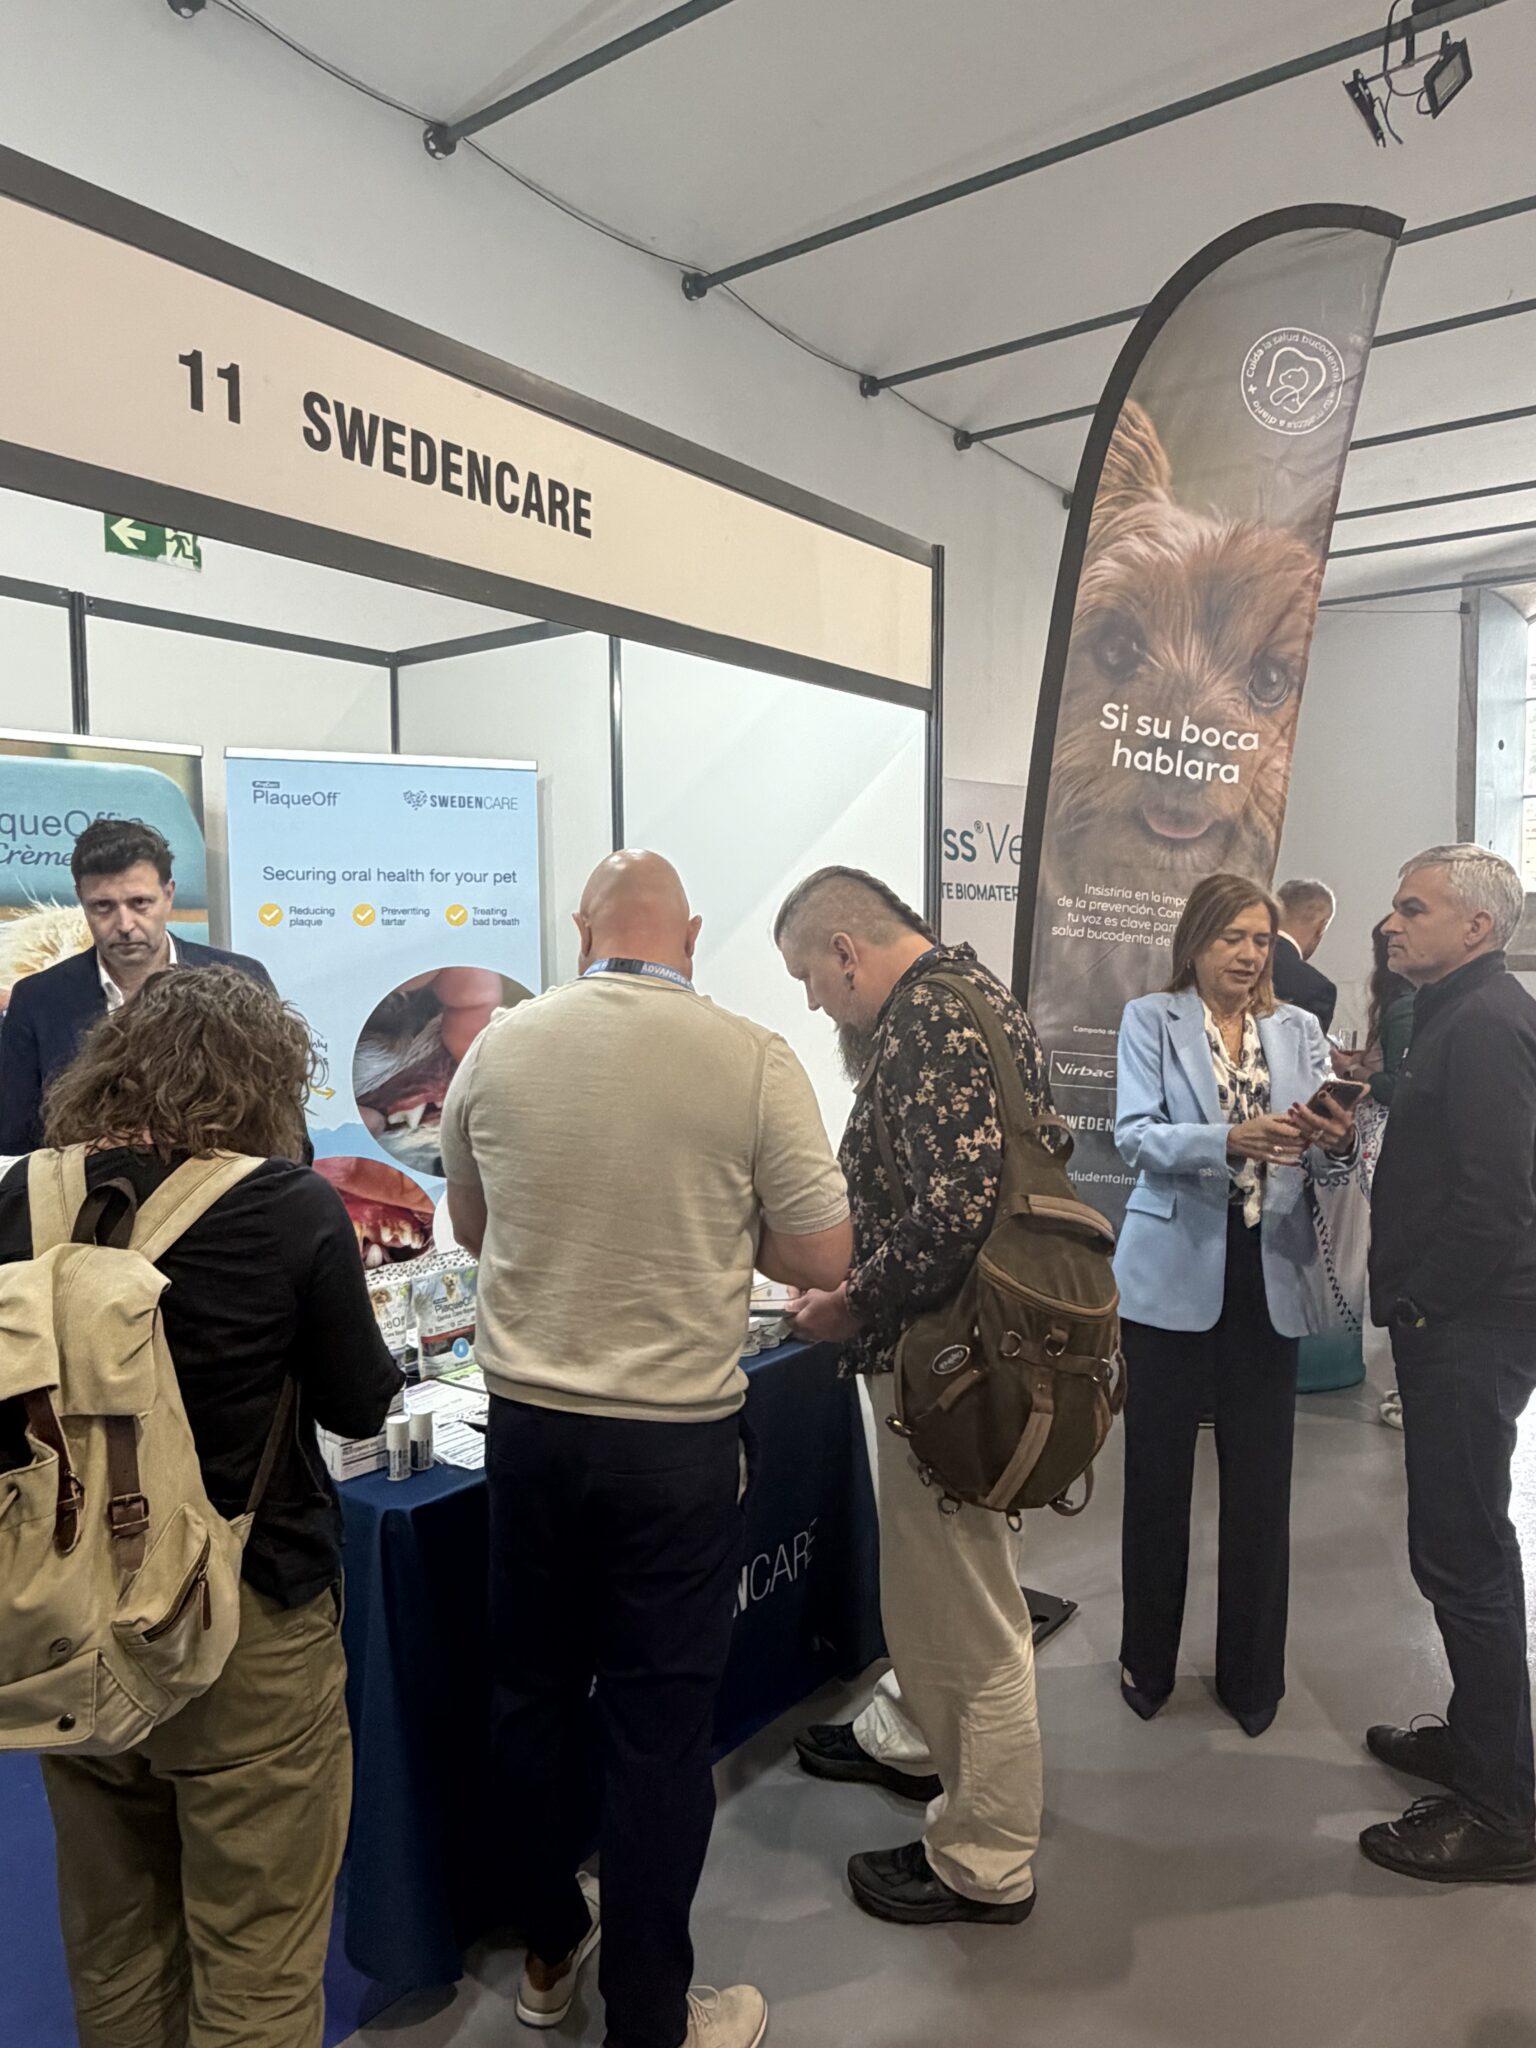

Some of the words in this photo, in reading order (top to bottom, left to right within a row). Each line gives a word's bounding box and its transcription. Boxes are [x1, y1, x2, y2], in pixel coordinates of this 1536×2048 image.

[178, 349, 241, 424] 11
[302, 391, 593, 539] SWEDENCARE
[1099, 702, 1128, 732] Si
[1135, 715, 1171, 740] su
[1180, 716, 1260, 751] boca
[1111, 740, 1240, 784] hablara
[429, 794, 519, 810] SWEDENCARE
[0, 810, 116, 842] queO
[263, 866, 336, 884] Securing
[341, 868, 372, 882] oral
[377, 868, 425, 883] health
[429, 868, 451, 883] for
[454, 871, 488, 886] your
[493, 870, 518, 886] pet
[1084, 883, 1132, 899] Insistiría
[1134, 891, 1149, 901] en
[1151, 891, 1161, 903] la
[289, 906, 335, 917] Reducing
[381, 907, 430, 918] Preventing
[472, 907, 508, 917] Treating
[1057, 895, 1073, 908] de
[1075, 897, 1086, 909] la
[1088, 900, 1156, 916] prevención.
[289, 917, 323, 927] plaque
[381, 917, 406, 926] tartar
[472, 917, 490, 926] bad
[492, 917, 520, 926] breath
[1067, 912, 1079, 923] tu
[1082, 914, 1102, 925] voz
[1104, 916, 1118, 927] es
[1120, 917, 1152, 930] clave
[1051, 925, 1085, 938] salud
[1087, 928, 1154, 944] bucodental
[1155, 935, 1171, 947] de
[1055, 1062, 1116, 1079] Virbac
